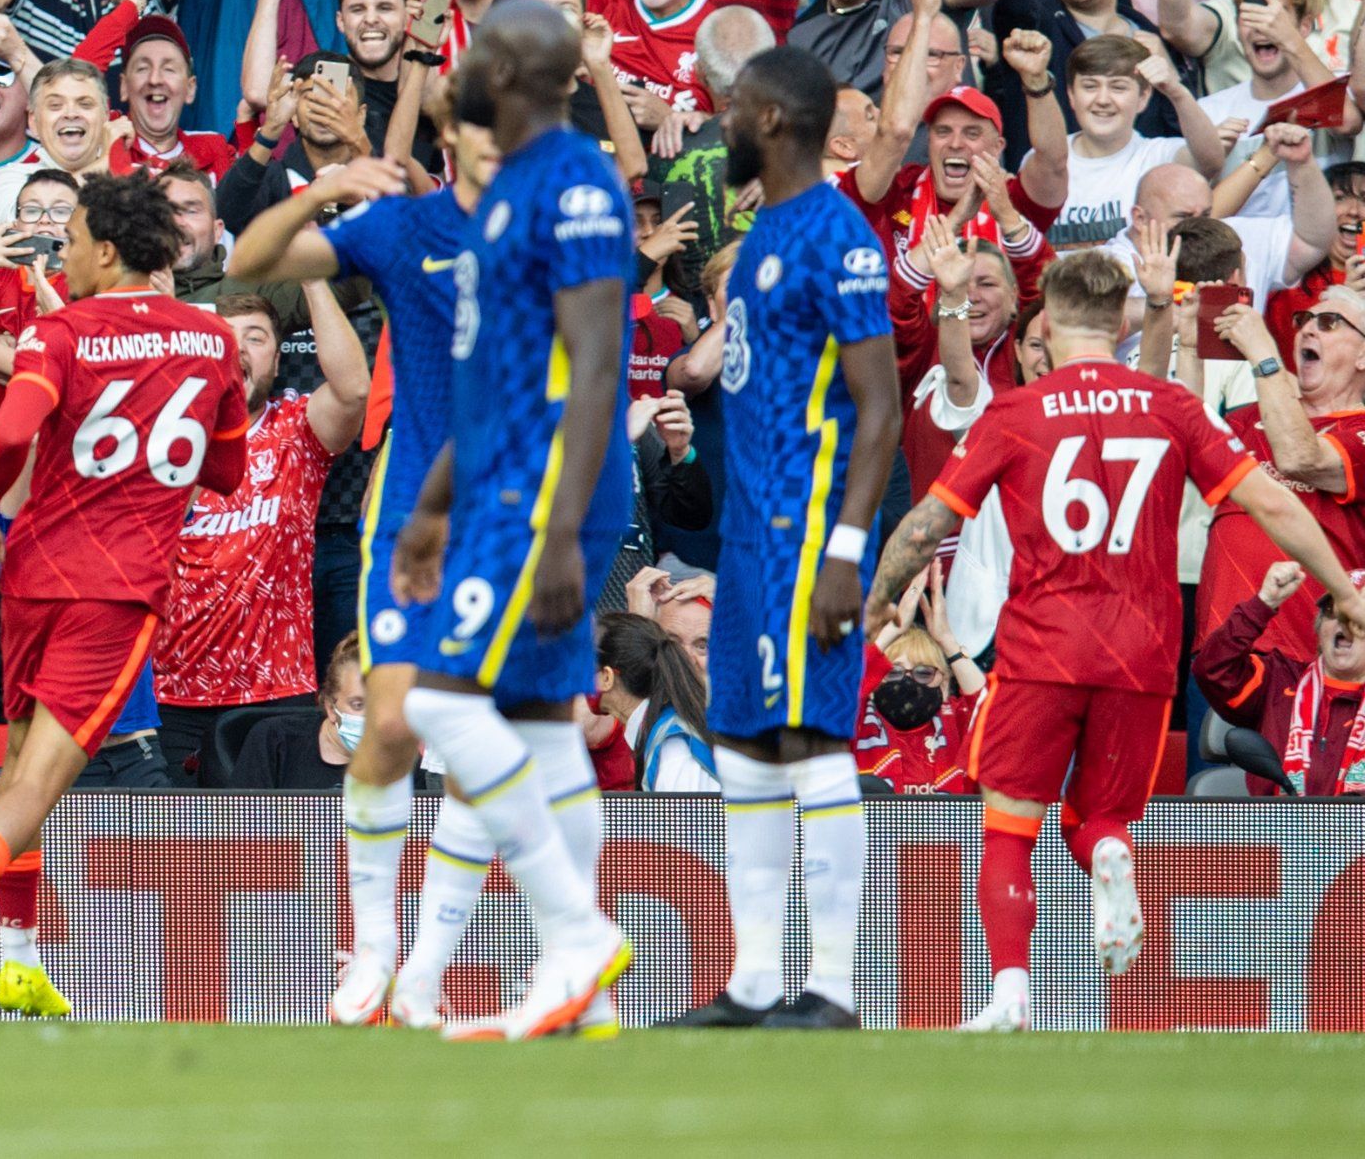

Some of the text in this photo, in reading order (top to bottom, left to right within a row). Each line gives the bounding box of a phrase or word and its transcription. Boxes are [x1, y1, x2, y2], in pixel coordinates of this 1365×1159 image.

[75, 330, 224, 362] ALEXANDER-ARNOLD
[72, 378, 207, 488] 66
[1043, 389, 1153, 418] ELLIOTT
[1043, 436, 1171, 555] 67
[452, 577, 494, 640] 9
[758, 634, 782, 690] 2
